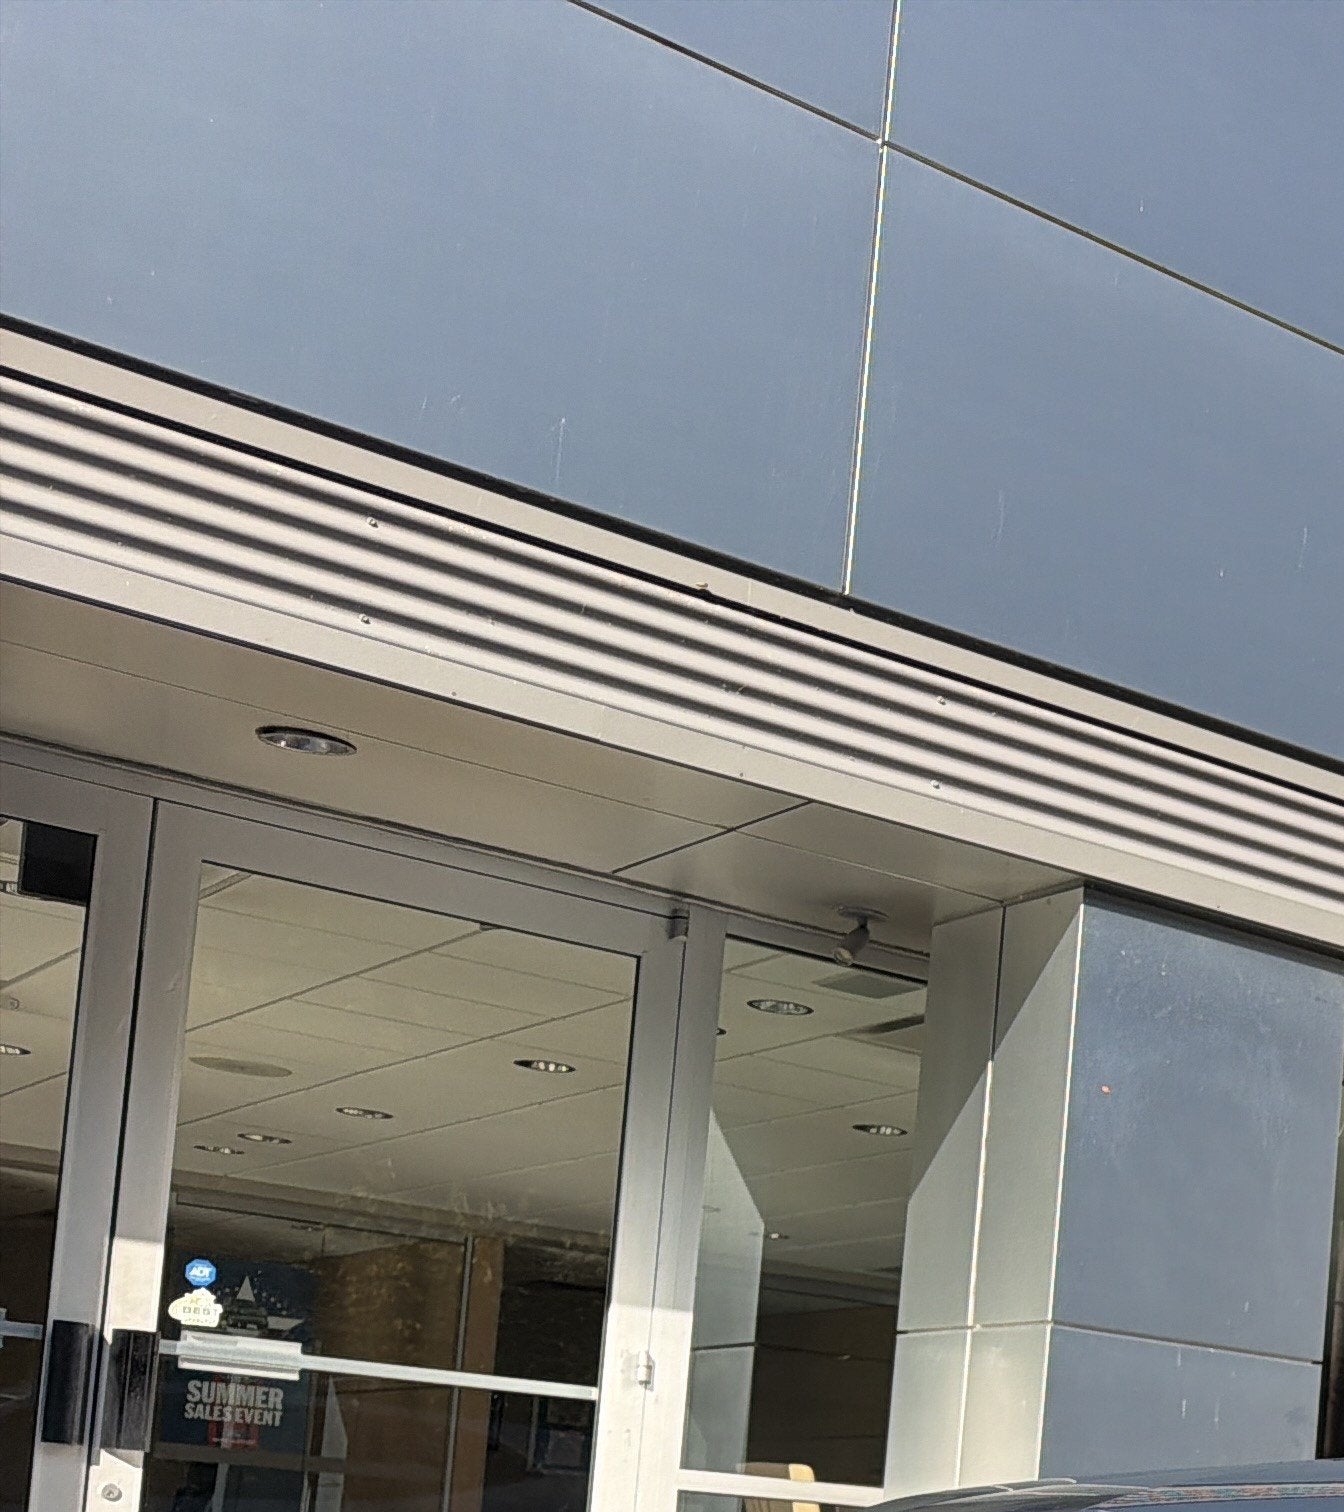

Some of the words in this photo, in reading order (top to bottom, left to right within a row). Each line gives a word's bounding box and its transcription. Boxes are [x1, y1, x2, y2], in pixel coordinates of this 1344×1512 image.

[189, 1266, 213, 1278] ADT
[186, 1379, 284, 1411] SUMMER
[184, 1402, 232, 1422] SALES
[234, 1407, 283, 1426] EVENT
